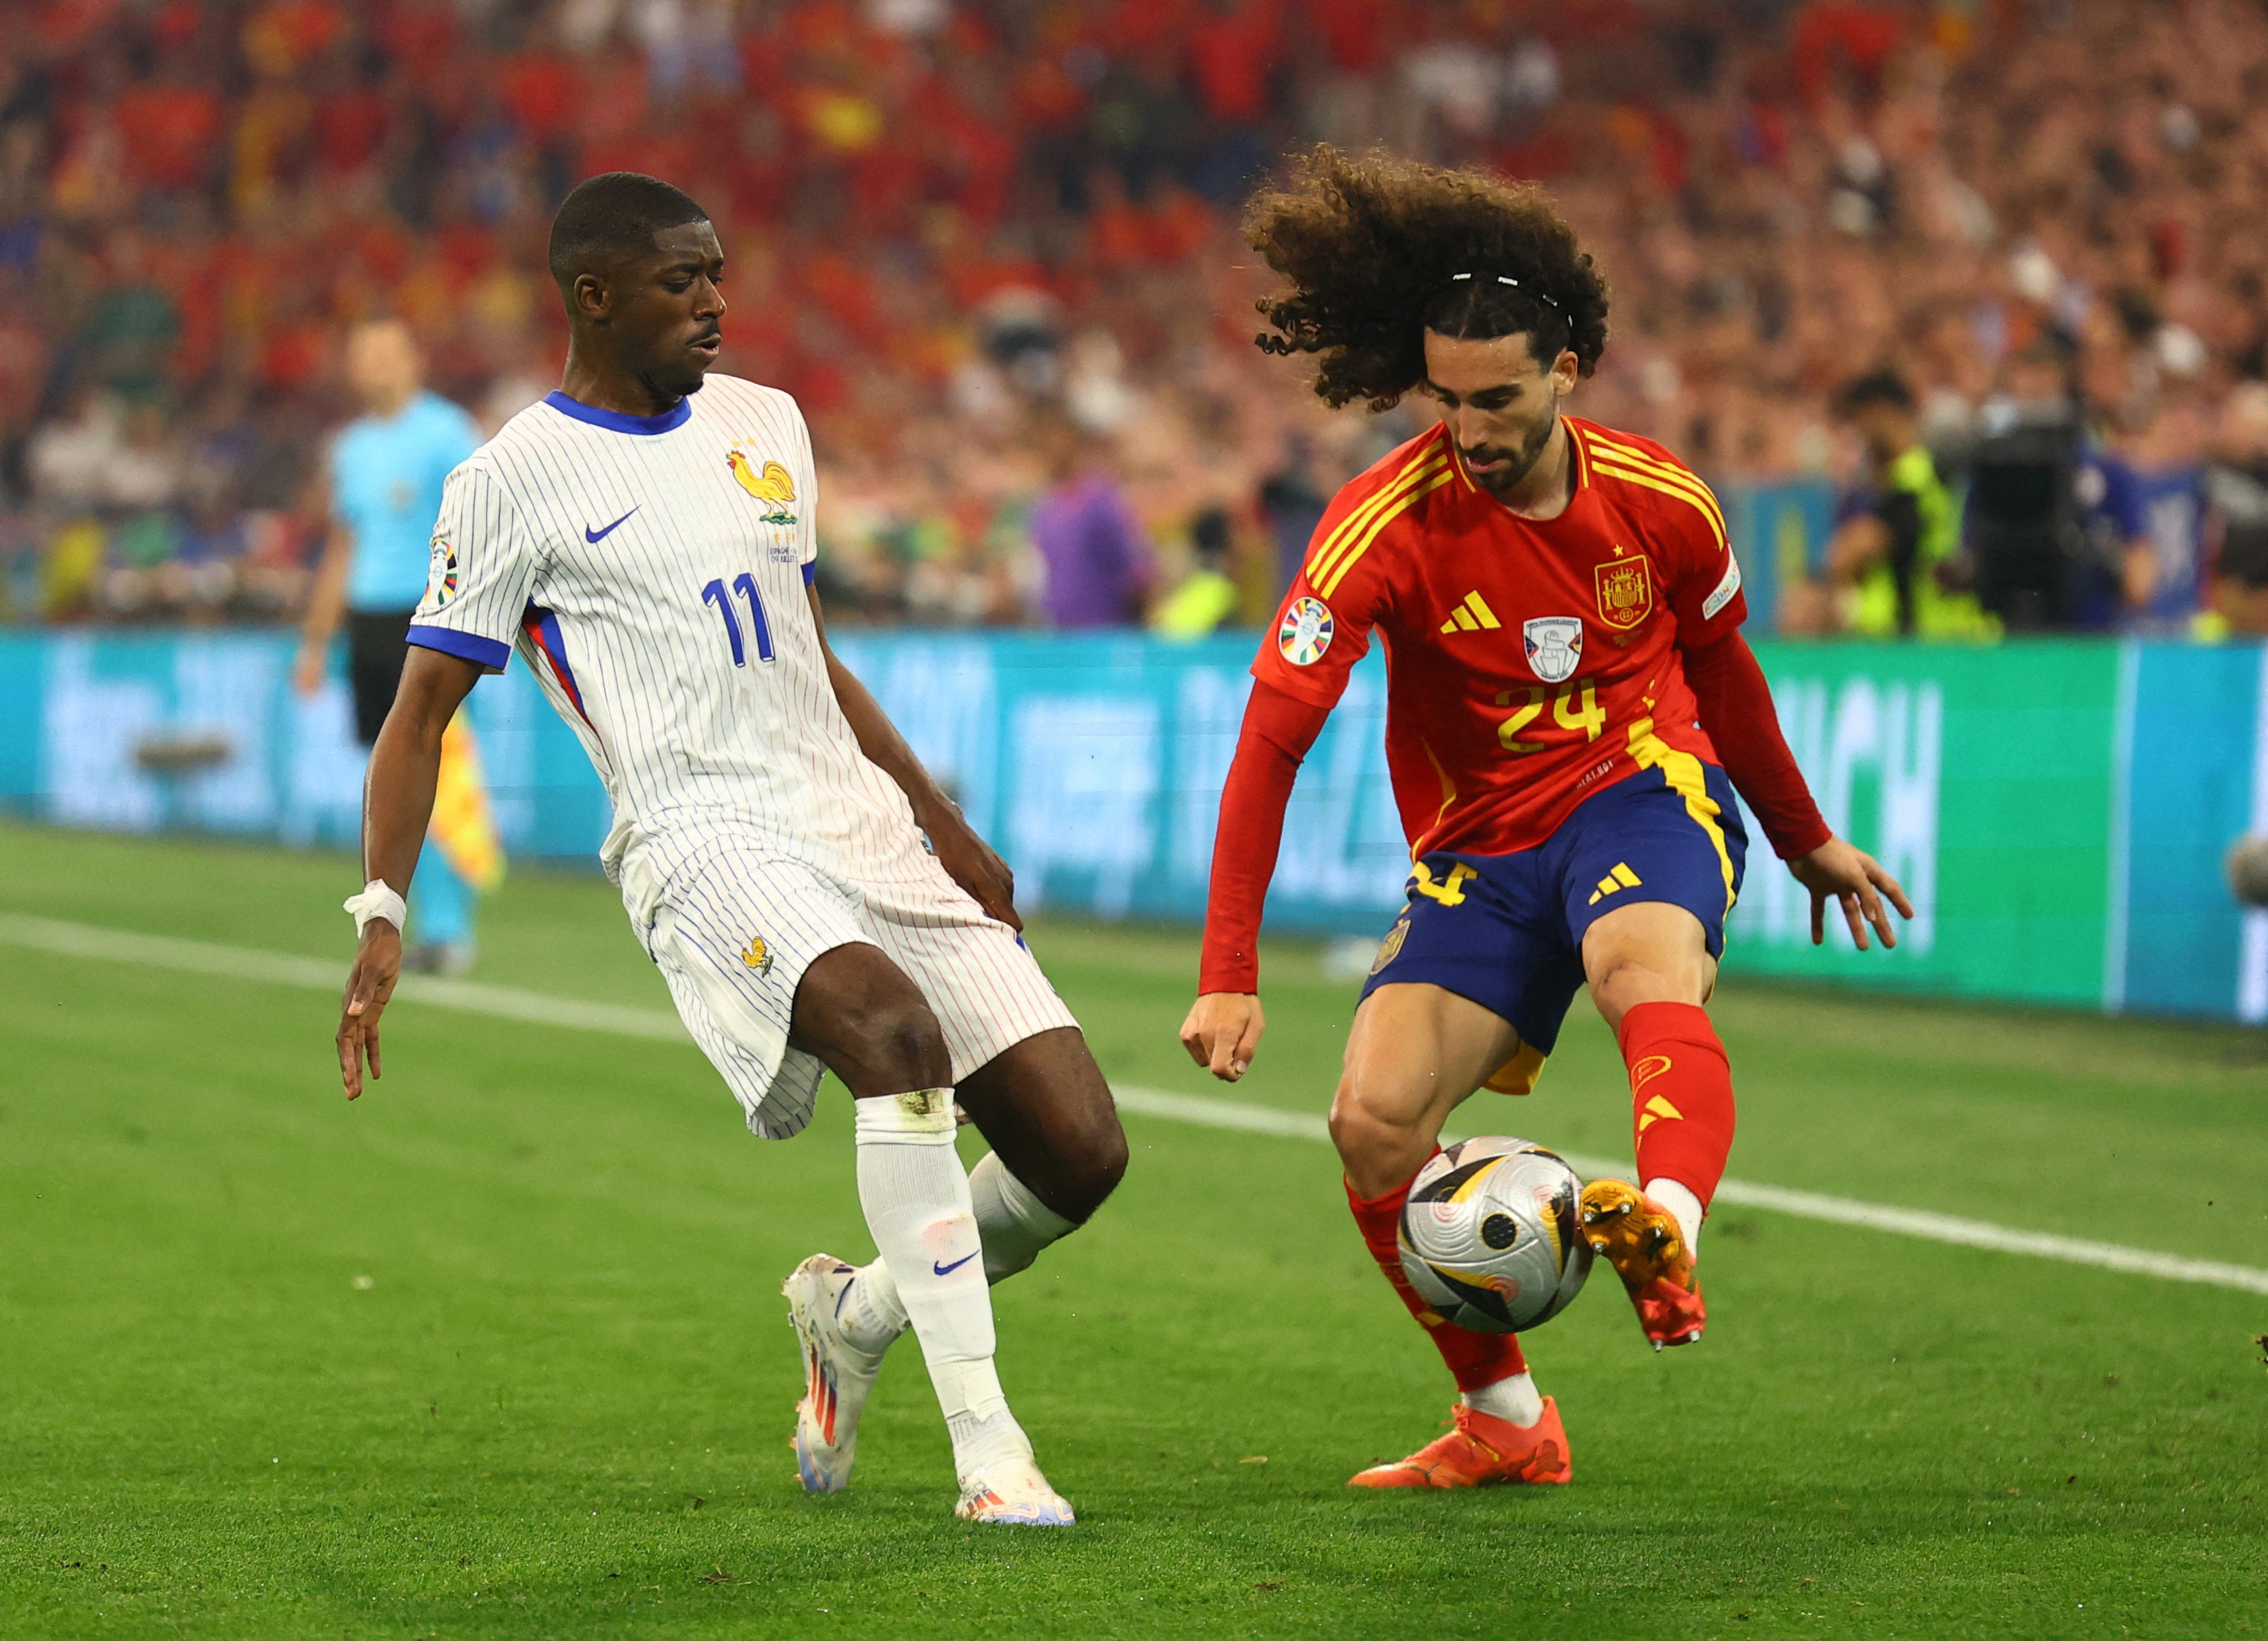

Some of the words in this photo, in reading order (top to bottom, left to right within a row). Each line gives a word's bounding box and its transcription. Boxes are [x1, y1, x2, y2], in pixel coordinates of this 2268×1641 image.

[1498, 276, 1518, 286] PUMA
[701, 572, 776, 668] 11
[1495, 677, 1606, 753] 24
